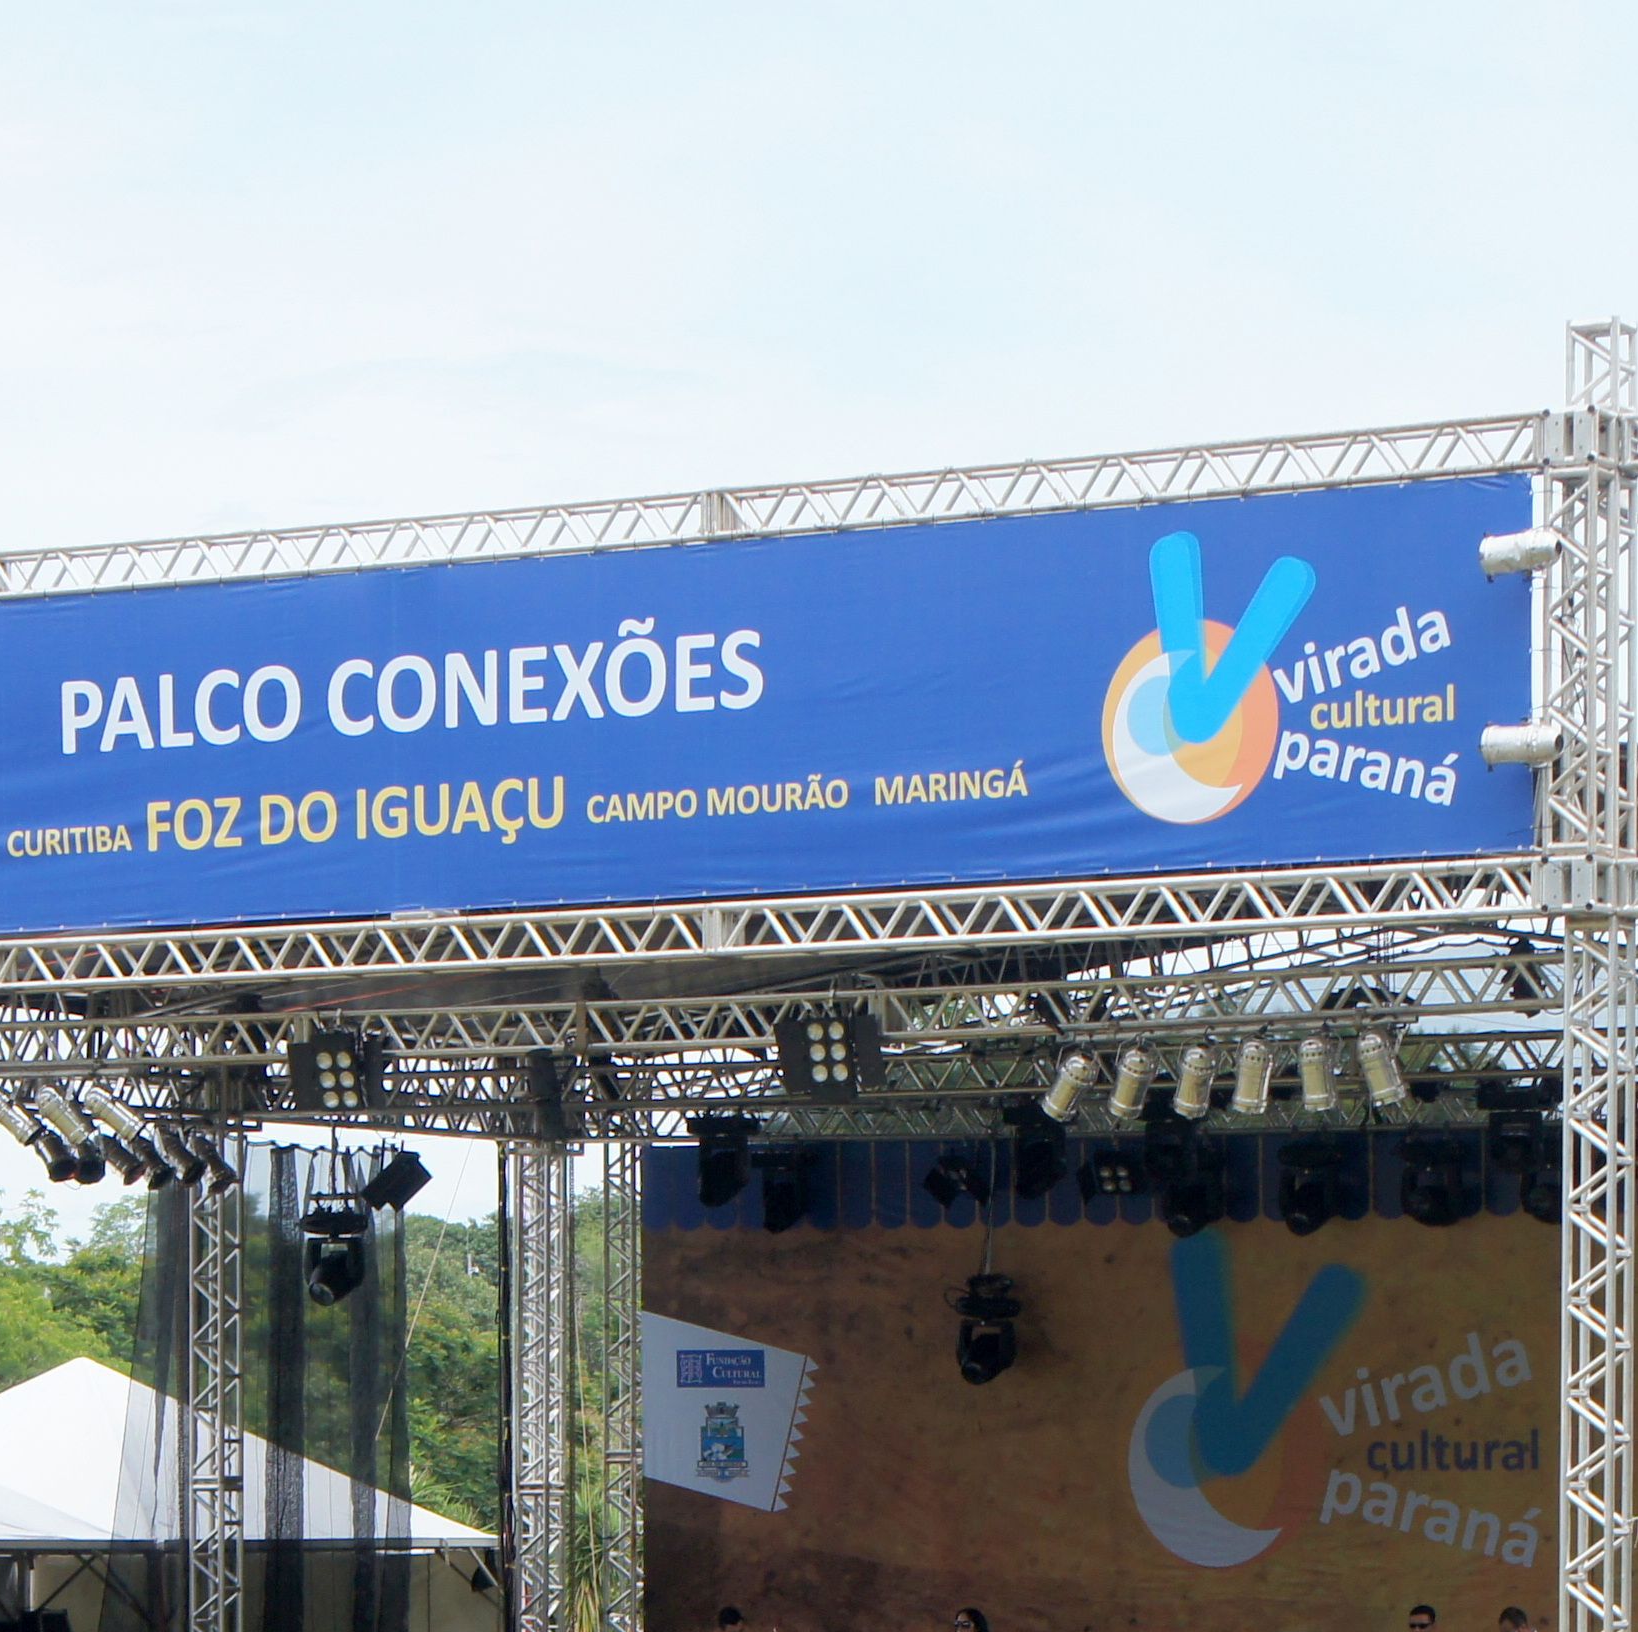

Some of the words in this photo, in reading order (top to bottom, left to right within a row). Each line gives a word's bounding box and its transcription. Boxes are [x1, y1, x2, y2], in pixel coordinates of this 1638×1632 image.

[61, 665, 302, 755] PALCO
[327, 616, 765, 737] CONEXÕES
[1272, 605, 1452, 704] virada
[1310, 682, 1455, 731] cultural
[6, 823, 134, 858] CURITIBA
[146, 796, 244, 853] FOZ
[259, 790, 340, 846] DO
[355, 775, 567, 845] IGUAÇU
[586, 788, 700, 824] CAMPO
[706, 773, 851, 817] MOURÃO
[874, 759, 1030, 806] MARINGÁ
[1272, 730, 1459, 807] paraná
[1320, 1332, 1532, 1436] virada
[1367, 1428, 1540, 1472] cultural
[1319, 1469, 1542, 1568] paraná
